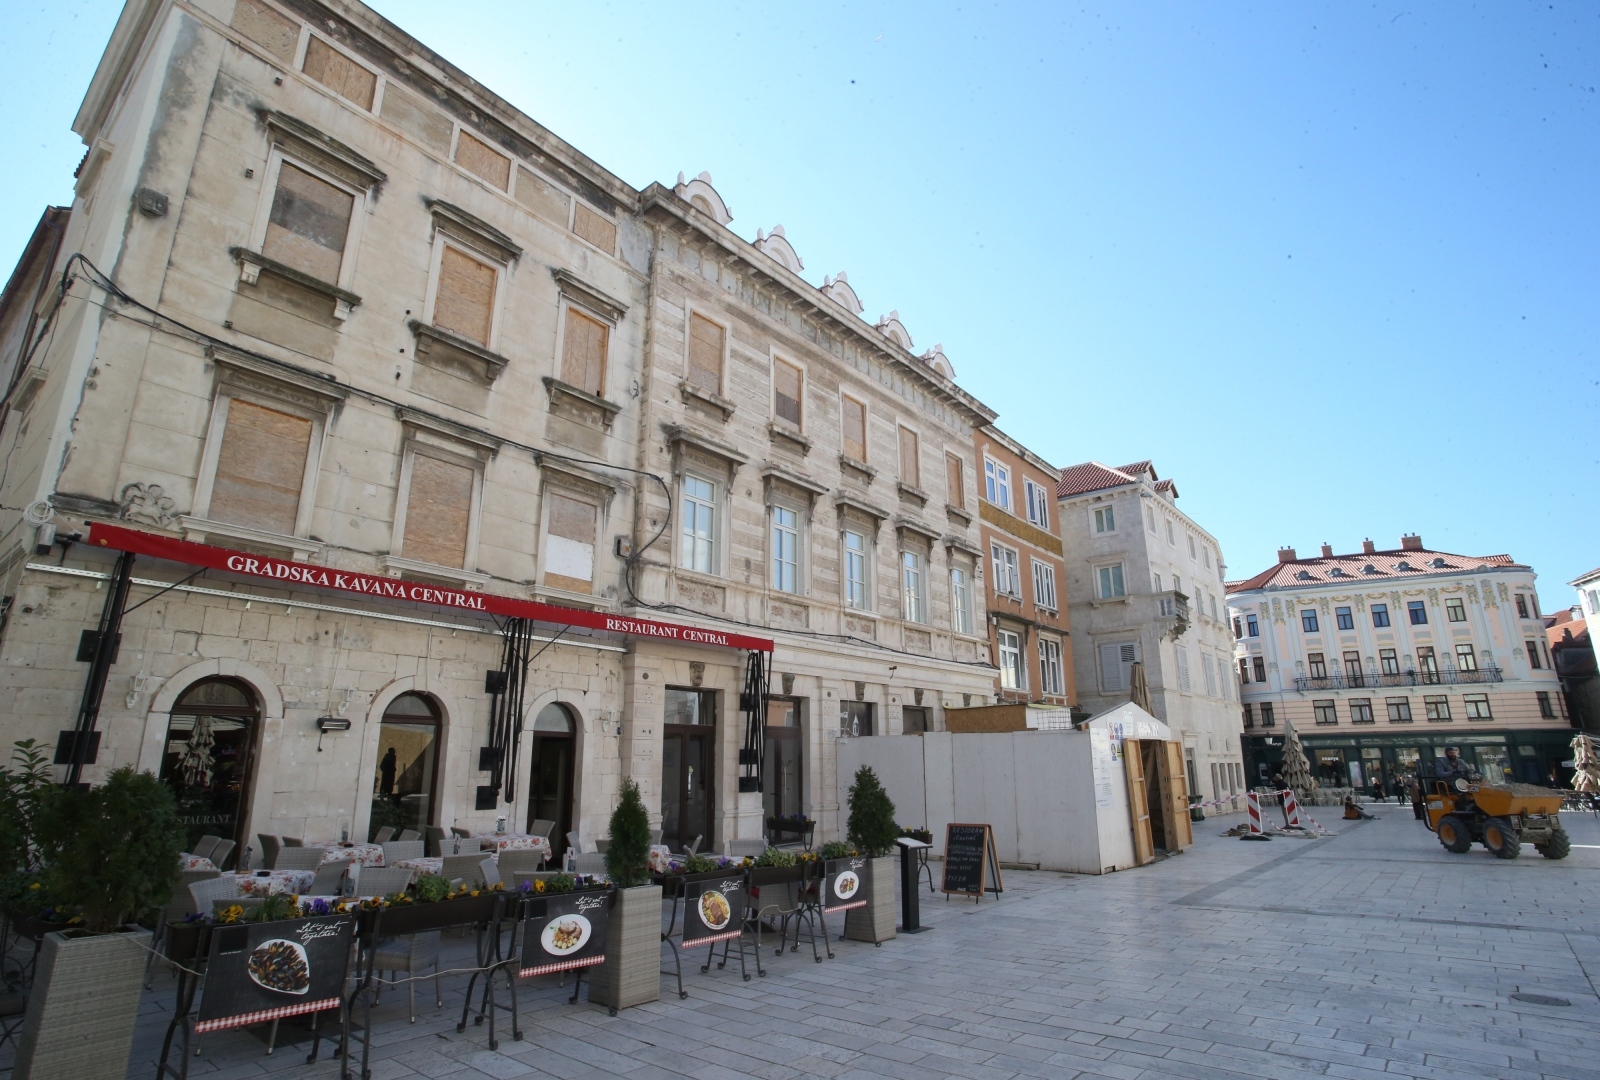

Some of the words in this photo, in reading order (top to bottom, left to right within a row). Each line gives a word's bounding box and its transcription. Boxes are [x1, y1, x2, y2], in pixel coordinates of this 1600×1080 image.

[227, 554, 329, 587] GRADSKA
[333, 574, 406, 599] KAVANA
[410, 587, 487, 611] CENTRAL
[606, 618, 678, 638] RESTAURANT
[683, 629, 729, 646] CENTRAL
[296, 922, 325, 933] Let's
[324, 920, 349, 929] eat
[300, 927, 341, 946] together!
